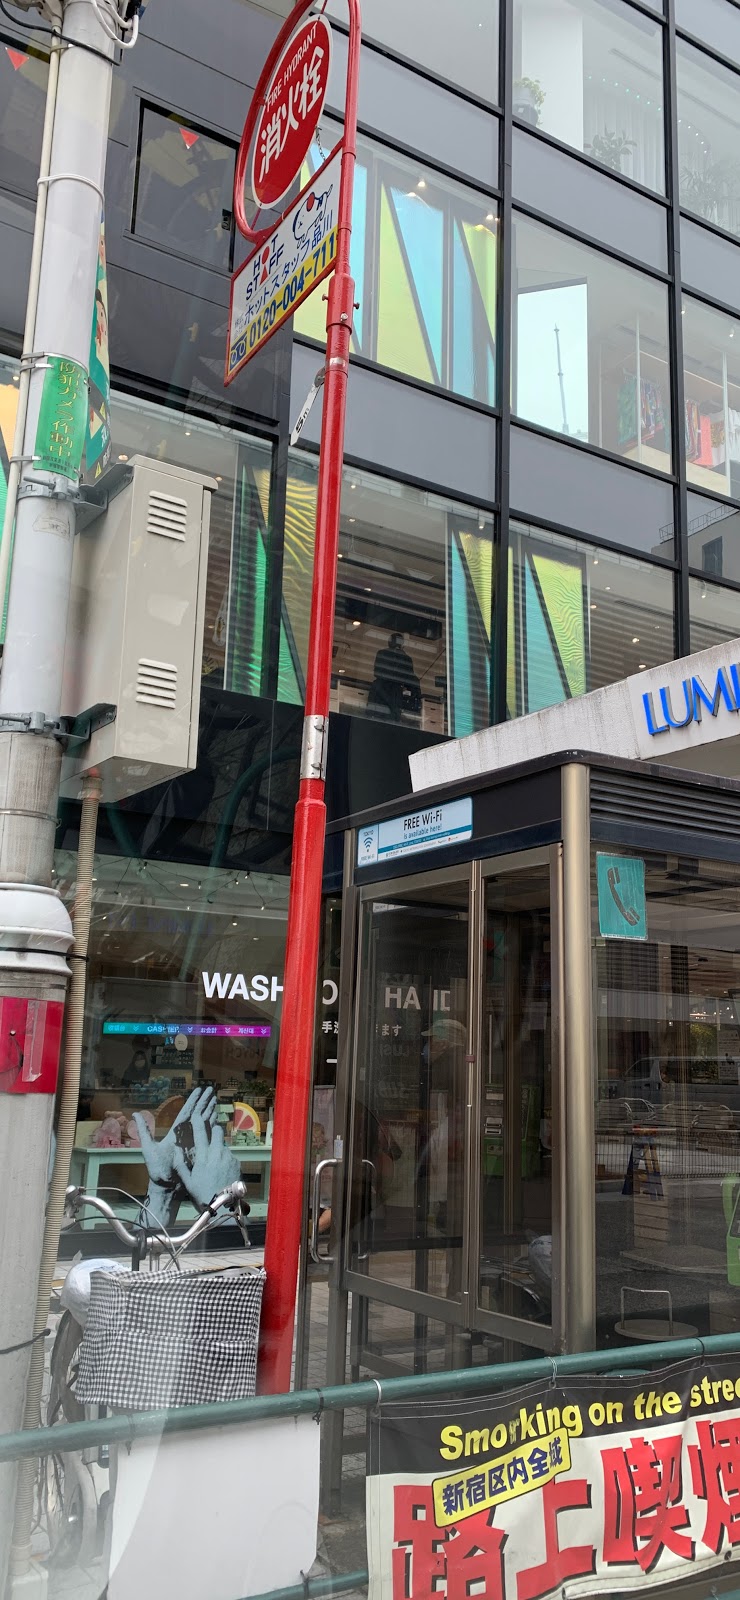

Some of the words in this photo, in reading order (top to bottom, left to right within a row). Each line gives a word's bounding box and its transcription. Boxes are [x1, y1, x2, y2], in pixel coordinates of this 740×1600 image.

[266, 79, 282, 112] FIRE
[283, 22, 318, 87] HYDRANT
[259, 45, 324, 183] 消火栓
[249, 231, 335, 345] 0120-004-711
[403, 815, 420, 831] FREE
[421, 809, 443, 827] Wi-Fi
[588, 1401, 624, 1426] on
[633, 1391, 683, 1420] the
[441, 1435, 564, 1517] 新宿区内全域
